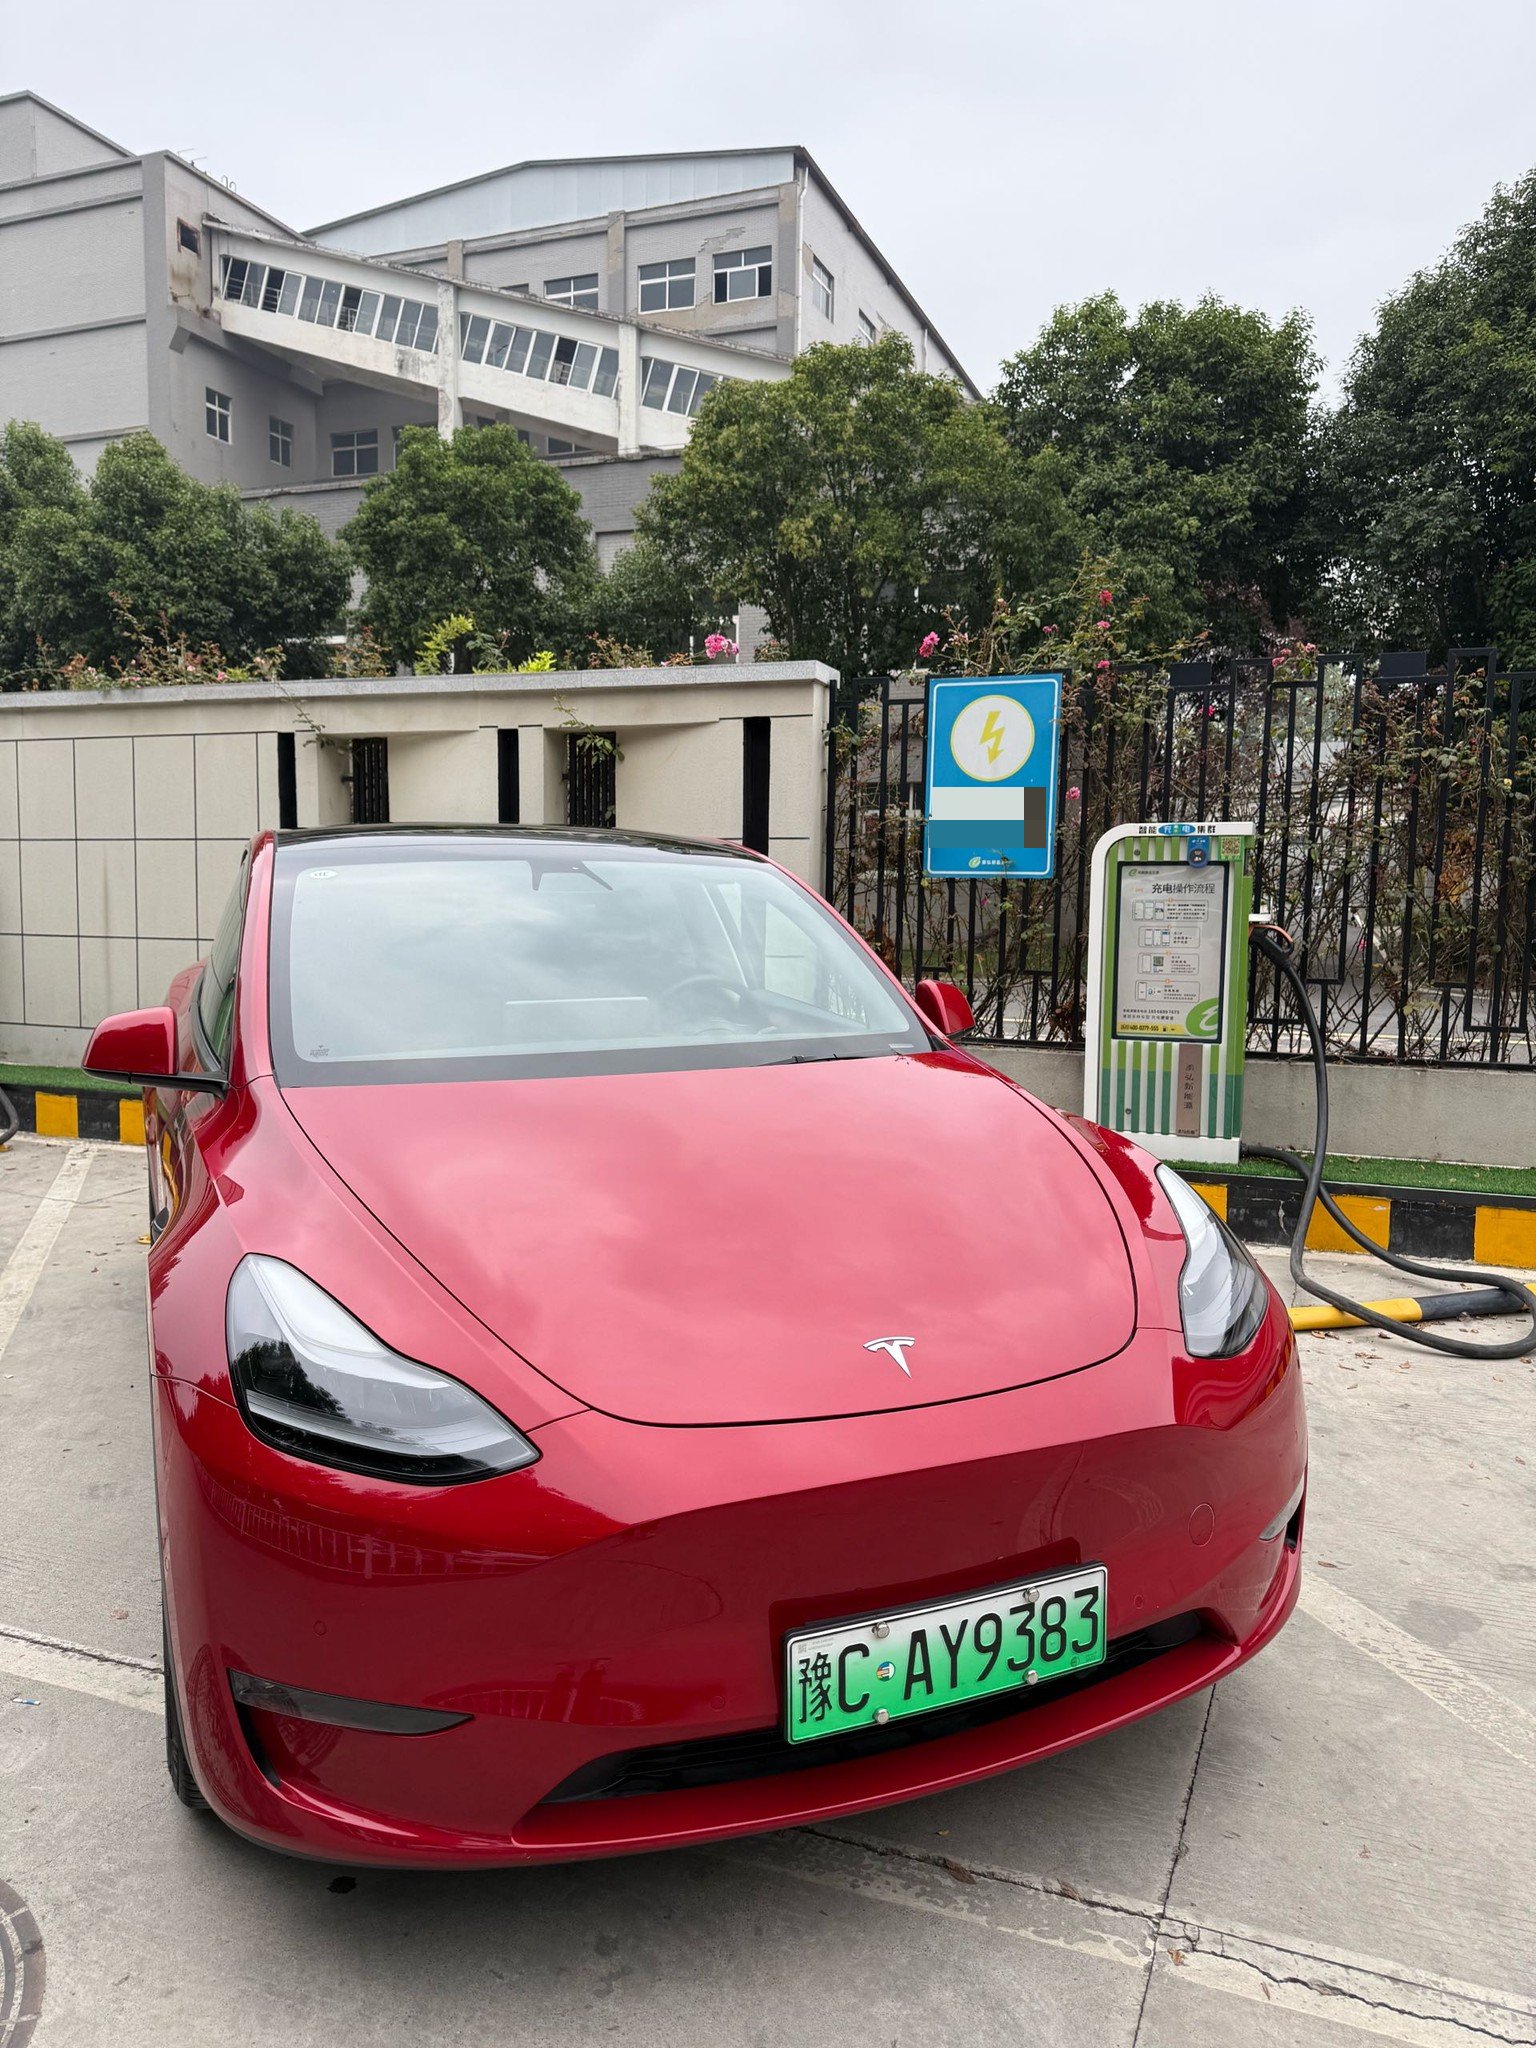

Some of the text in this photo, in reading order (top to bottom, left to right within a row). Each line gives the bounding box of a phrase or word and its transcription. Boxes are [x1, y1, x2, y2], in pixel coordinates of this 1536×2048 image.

[1151, 883, 1216, 895] 充电操作流程
[903, 1585, 1099, 1700] AY9383
